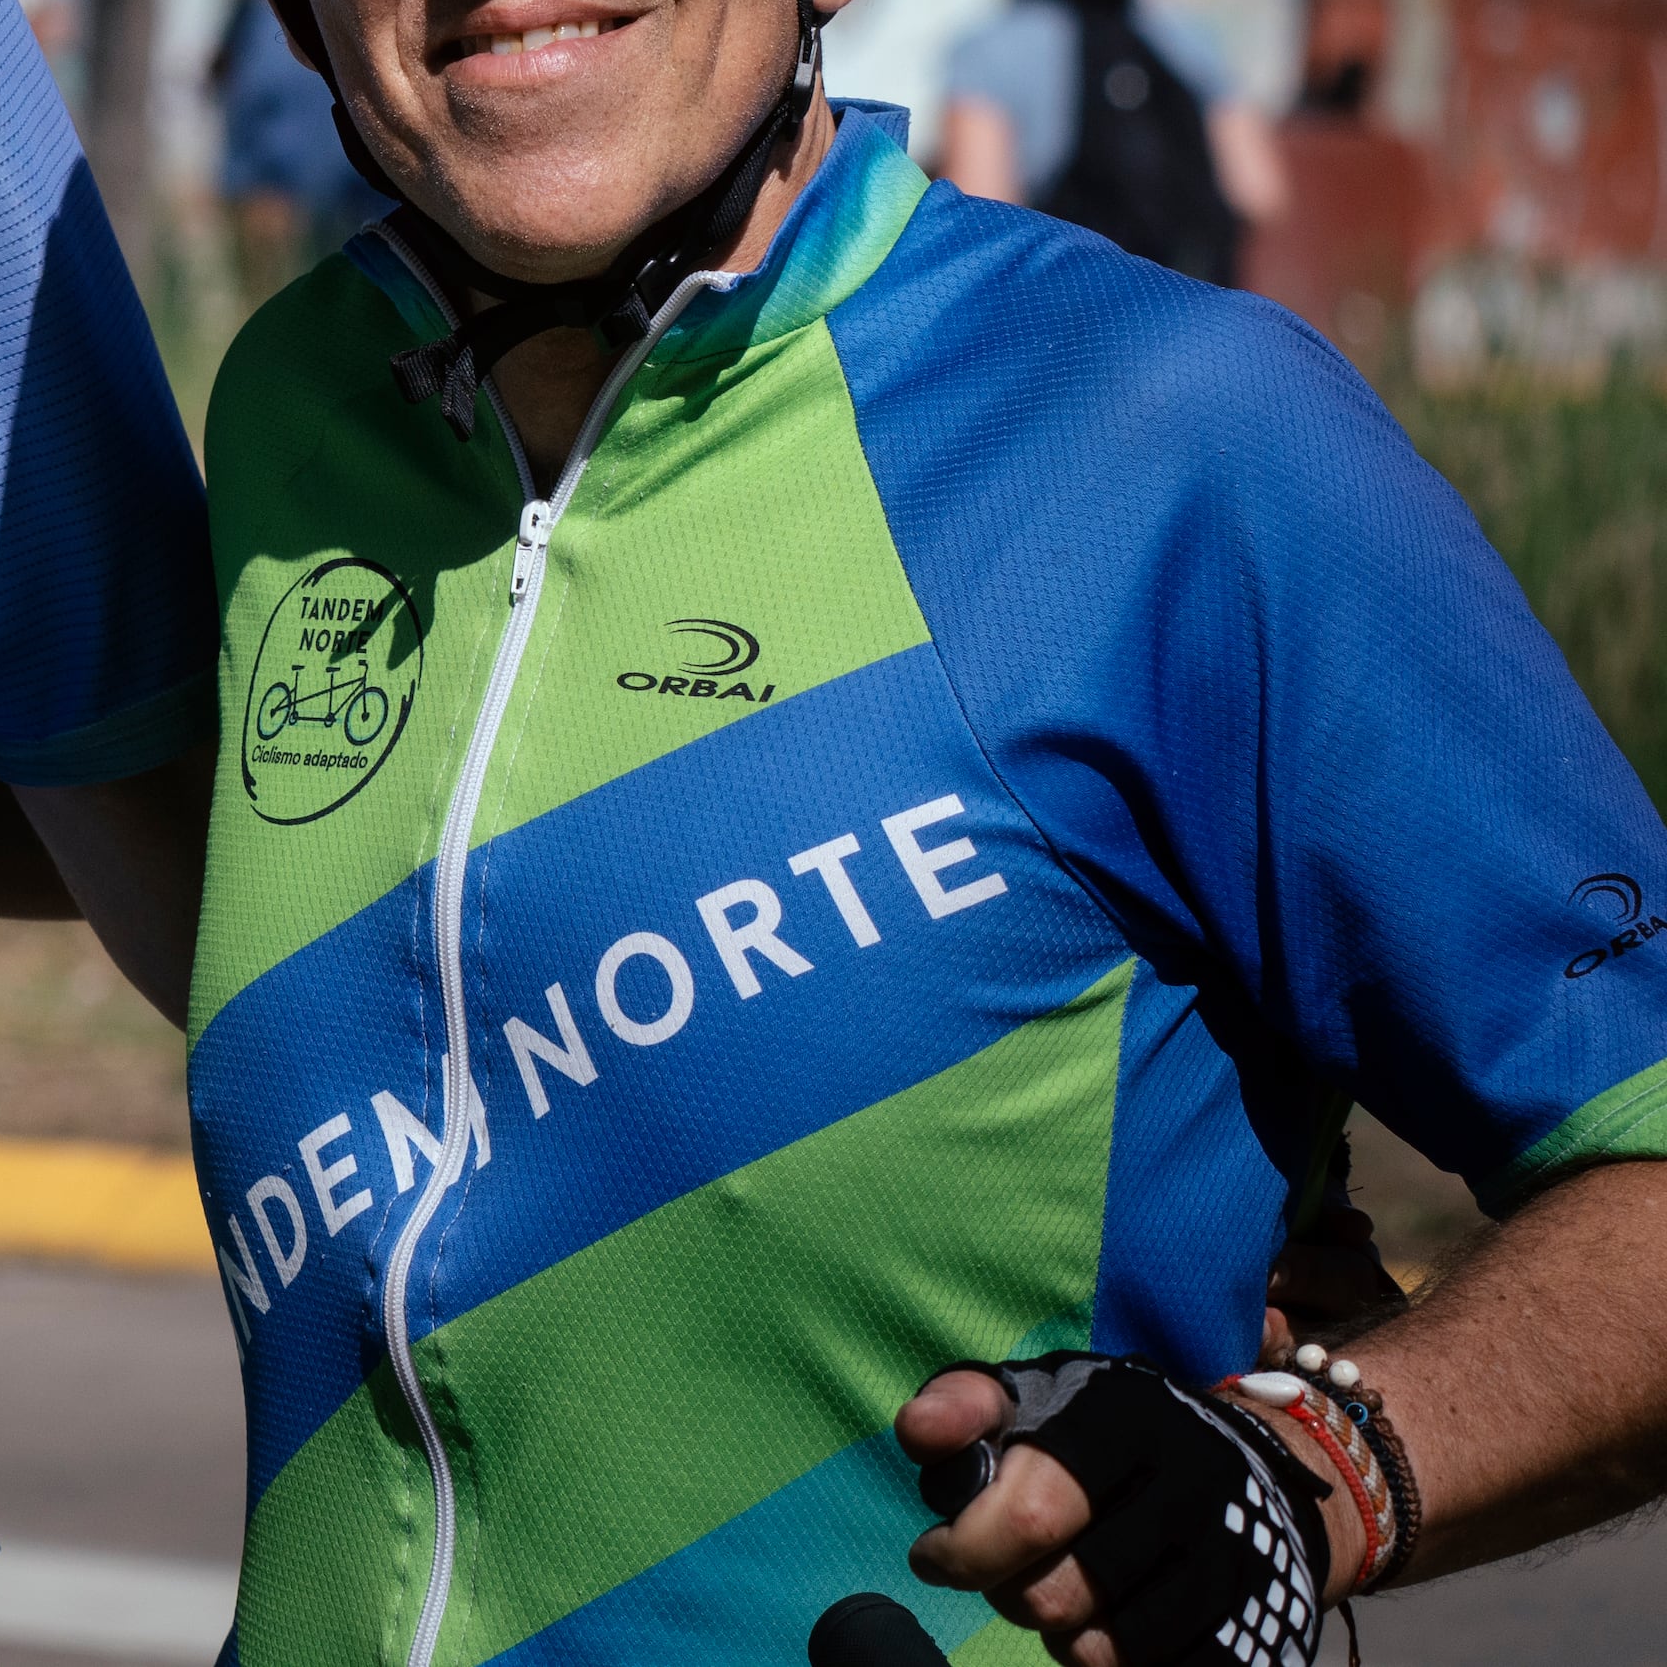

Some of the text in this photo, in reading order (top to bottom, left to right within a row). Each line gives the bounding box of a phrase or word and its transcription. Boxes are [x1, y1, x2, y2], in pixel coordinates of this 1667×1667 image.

[300, 596, 385, 623] TANDEM
[299, 628, 369, 654] NORTE
[616, 671, 777, 703] ORBAI
[251, 745, 369, 772] Ciclismo adaptado
[503, 792, 1009, 1120] NORTE
